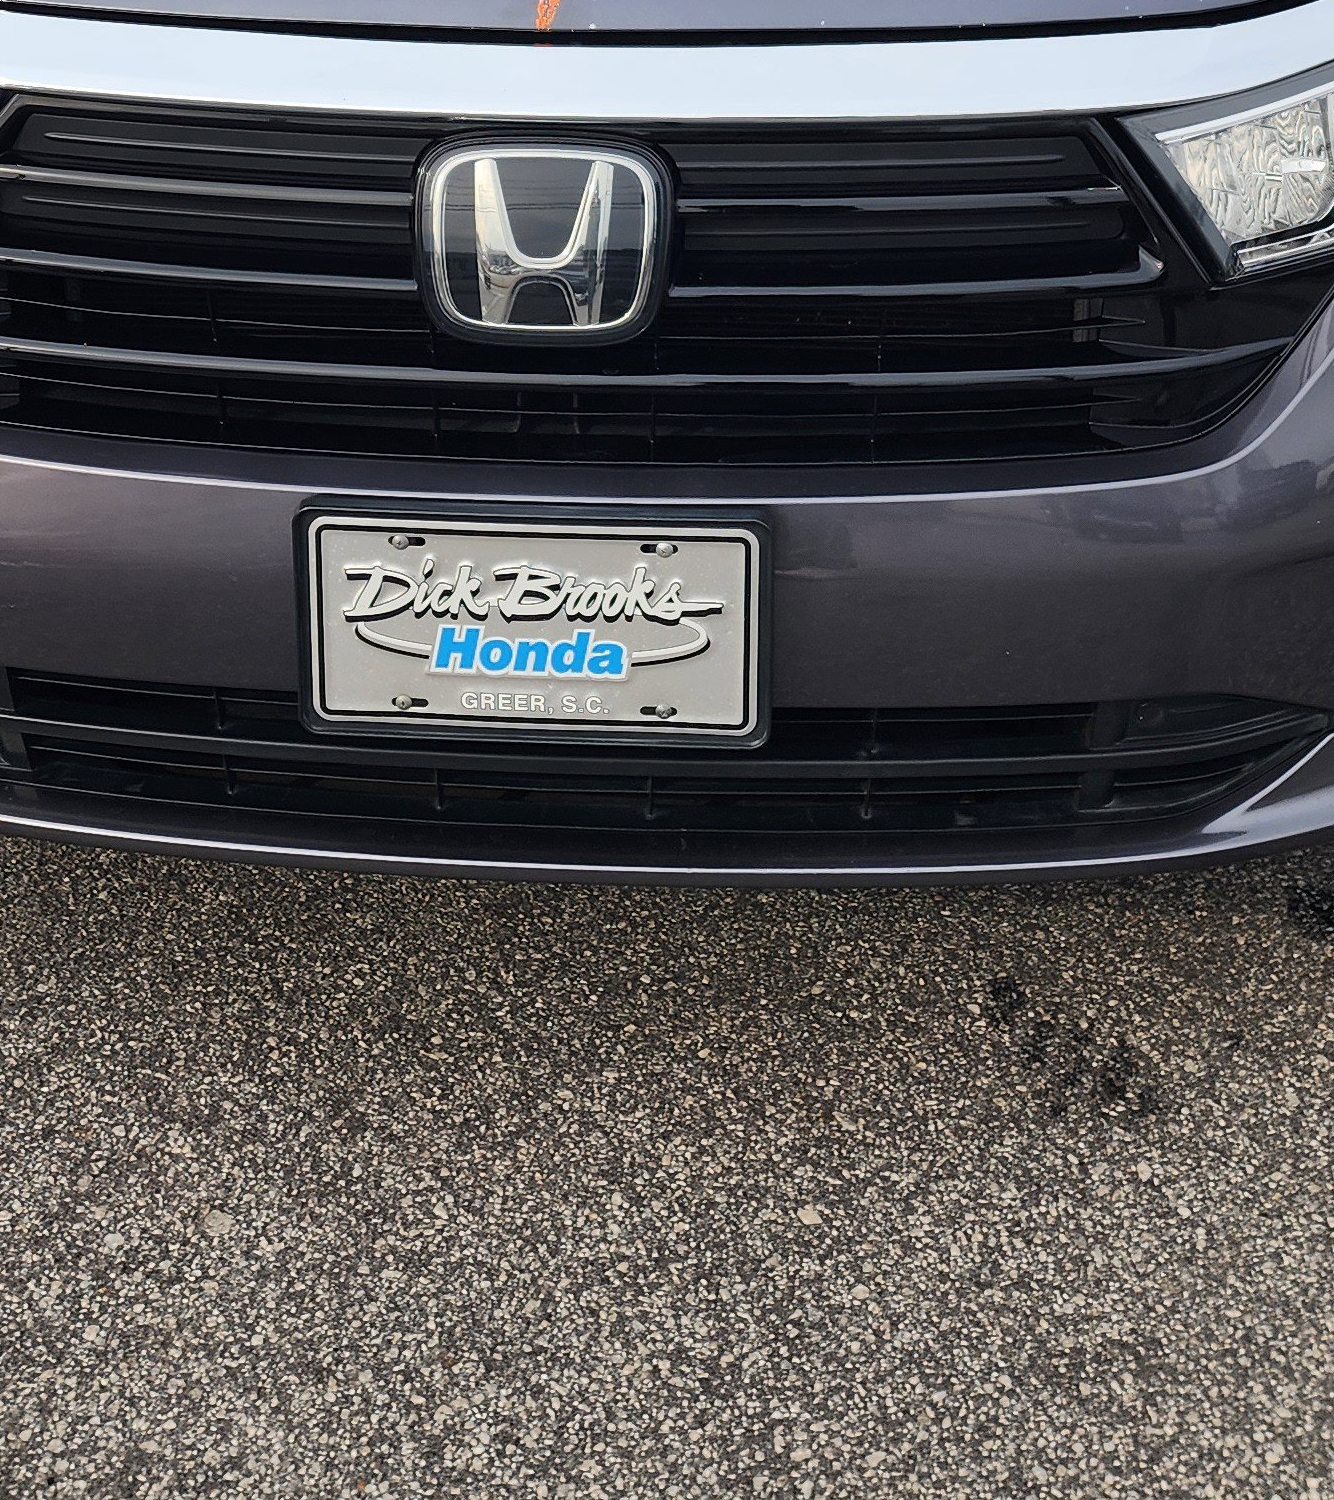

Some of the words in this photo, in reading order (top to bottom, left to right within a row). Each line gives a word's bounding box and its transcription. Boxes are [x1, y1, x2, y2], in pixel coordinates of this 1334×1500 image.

[343, 559, 492, 622] Dick
[491, 564, 723, 624] Brooks
[431, 624, 627, 678] Honda
[461, 691, 555, 715] GREER,
[561, 694, 610, 715] S.C.
